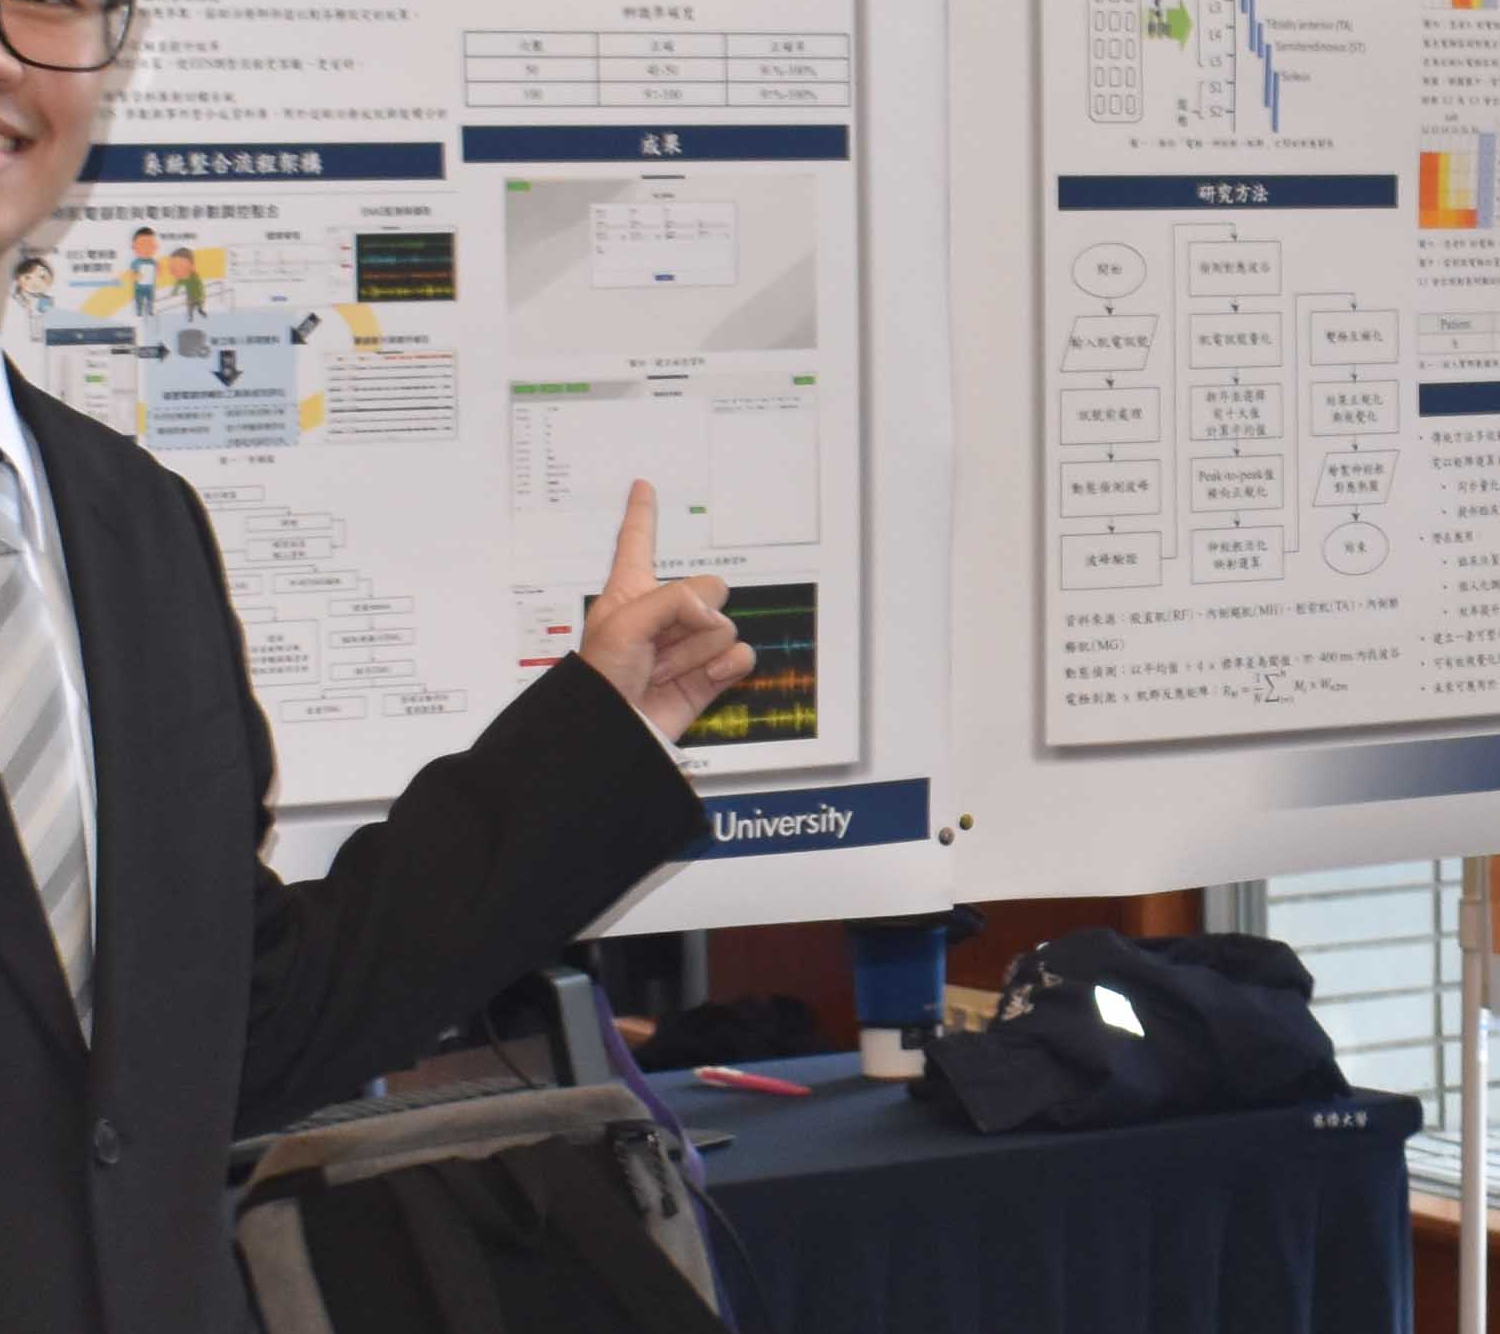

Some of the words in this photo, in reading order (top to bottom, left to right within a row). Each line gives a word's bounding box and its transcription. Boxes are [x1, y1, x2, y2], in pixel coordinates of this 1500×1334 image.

[1197, 182, 1269, 204] 研究方法
[713, 803, 854, 845] University
